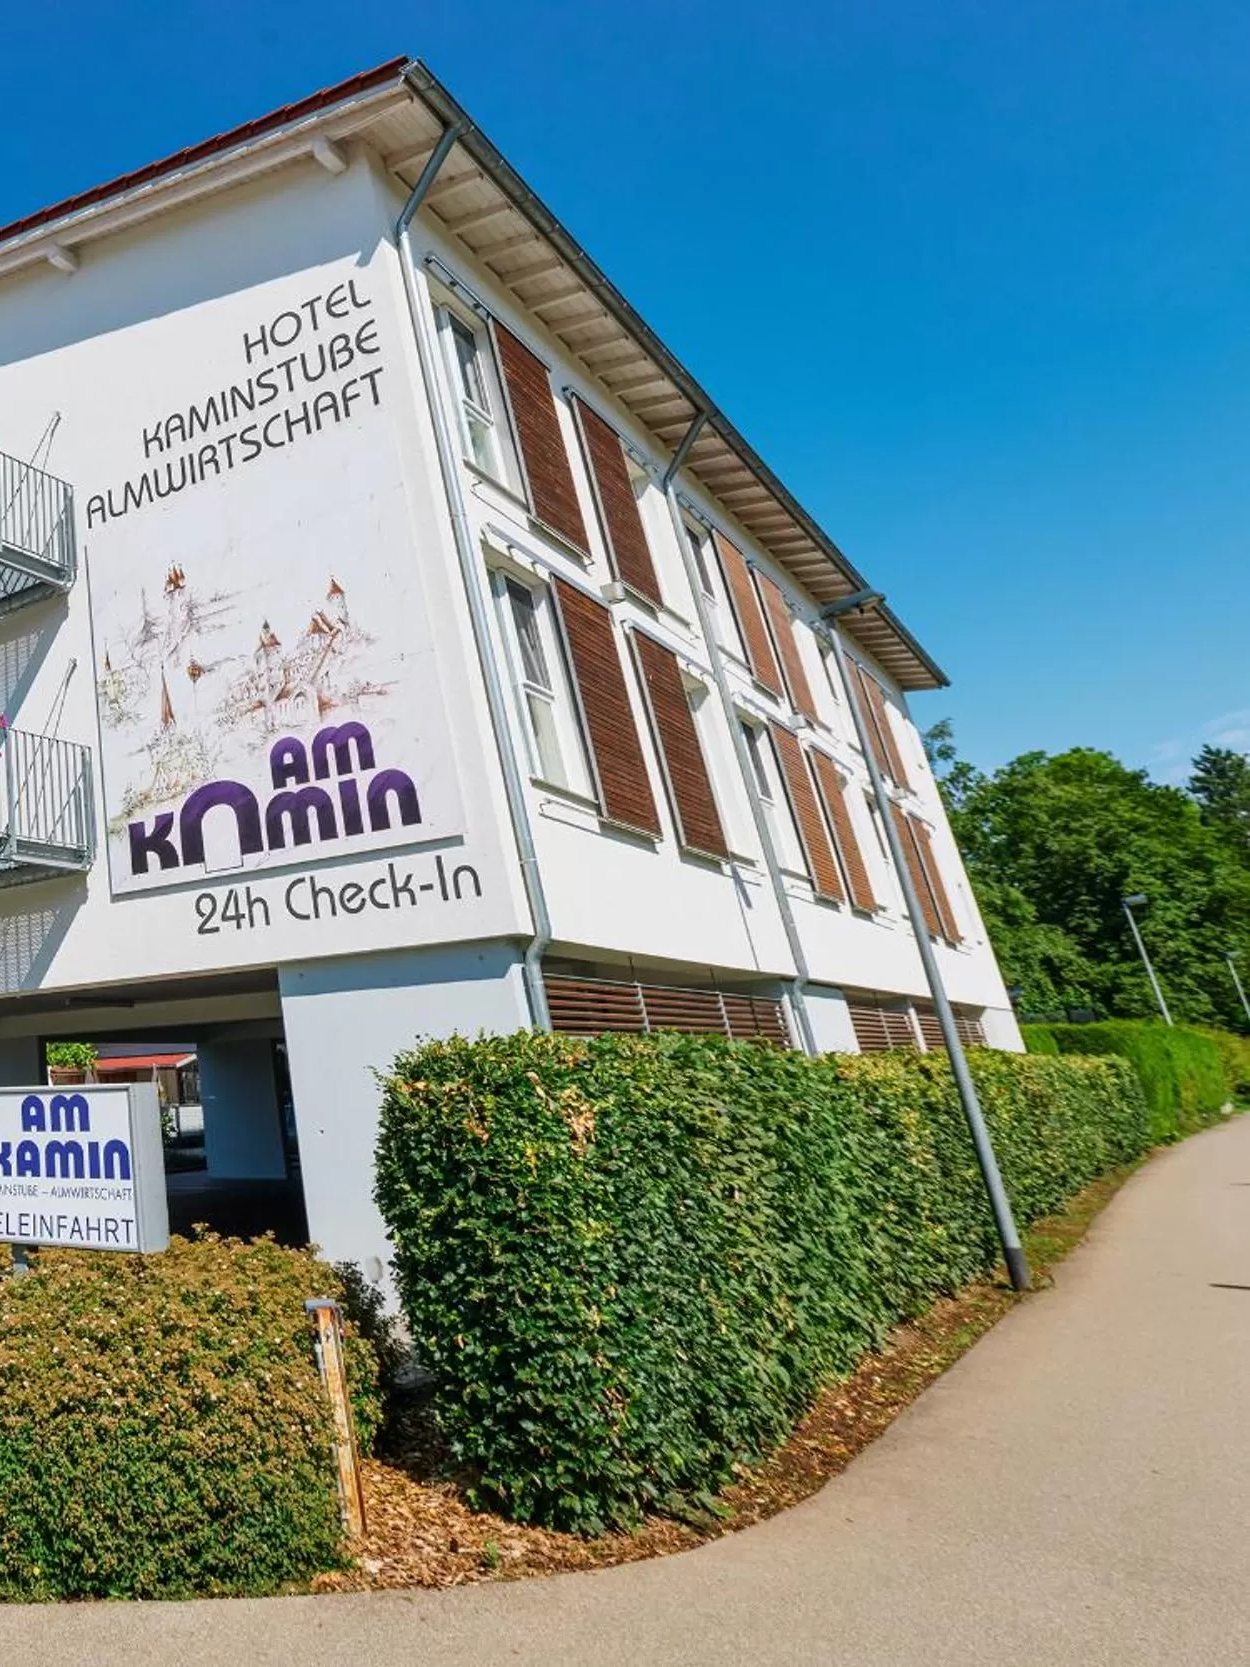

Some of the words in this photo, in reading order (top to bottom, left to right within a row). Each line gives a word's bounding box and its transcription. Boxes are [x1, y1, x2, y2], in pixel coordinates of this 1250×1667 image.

[243, 279, 371, 364] HOTEL
[142, 319, 380, 458] KAMINSTUBE
[86, 367, 383, 529] ALMWIRTSCHAFT
[269, 720, 375, 790] AM
[195, 885, 270, 935] 24h
[285, 855, 482, 920] Check-In
[21, 1094, 90, 1132] AM
